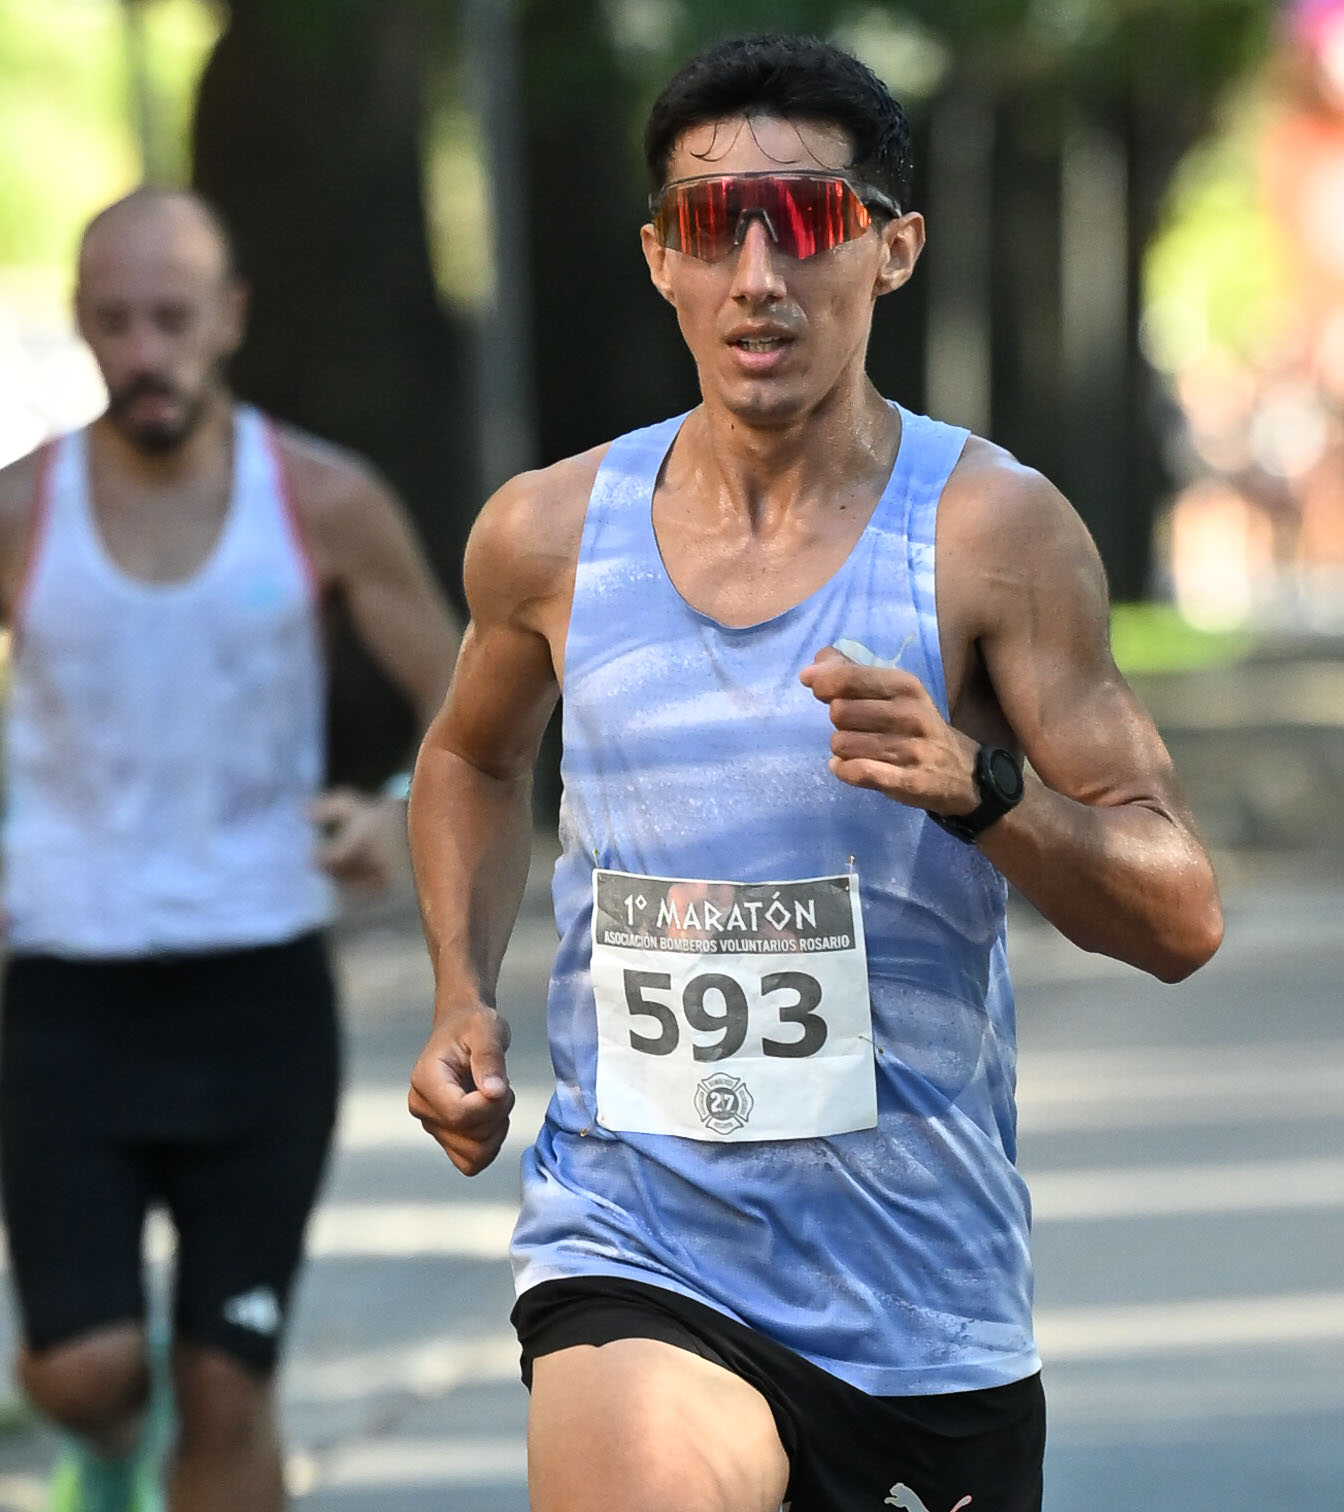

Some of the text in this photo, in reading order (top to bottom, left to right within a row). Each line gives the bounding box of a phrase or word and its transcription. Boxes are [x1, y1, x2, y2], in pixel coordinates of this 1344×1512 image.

[656, 891, 816, 932] MARATÓN
[604, 930, 851, 953] ASOCIACIÓN BOMBEROS VOLUNTARIOS ROSARIO
[622, 968, 828, 1062] 593
[709, 1091, 735, 1113] 27
